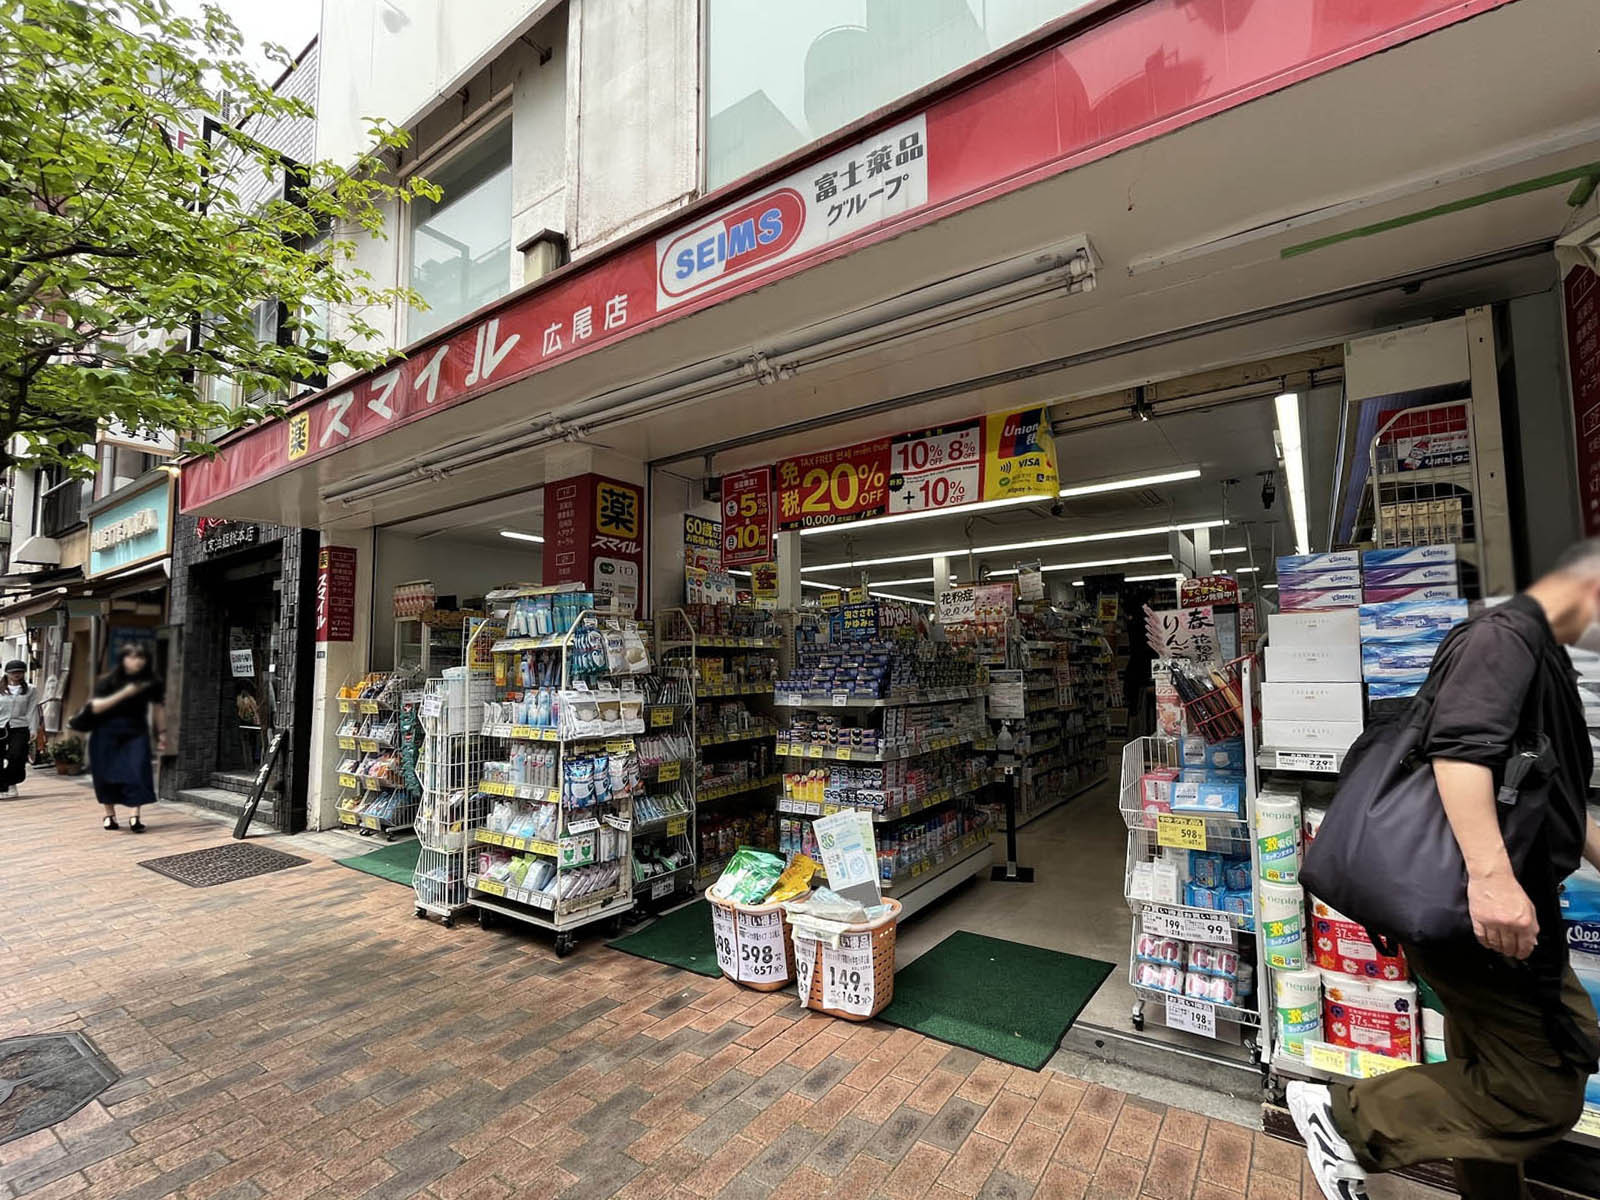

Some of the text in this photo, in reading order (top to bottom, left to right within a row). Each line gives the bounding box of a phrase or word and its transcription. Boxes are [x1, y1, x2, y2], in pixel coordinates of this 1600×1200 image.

[814, 131, 923, 203] 富士薬品
[827, 173, 910, 227] グループ
[675, 207, 783, 280] SEIMS
[541, 294, 628, 357] 広尾店
[319, 319, 520, 447] スマイル
[929, 457, 943, 466] OFF
[1018, 458, 1041, 467] VISA
[781, 461, 800, 517] 免税
[859, 489, 884, 505] OFF
[950, 494, 965, 504] OFF
[600, 488, 634, 533] 薬
[801, 514, 836, 527] 10,000
[591, 535, 641, 554] スマイル
[316, 573, 327, 630] スマイル
[941, 589, 974, 605] 花粉症
[1181, 828, 1197, 839] 598
[1165, 919, 1180, 929] 199
[1207, 925, 1223, 935] 99
[742, 943, 773, 964] 598
[754, 965, 773, 975] 657
[830, 966, 860, 992] 149
[842, 991, 860, 1005] 163
[1191, 1012, 1207, 1024] 198
